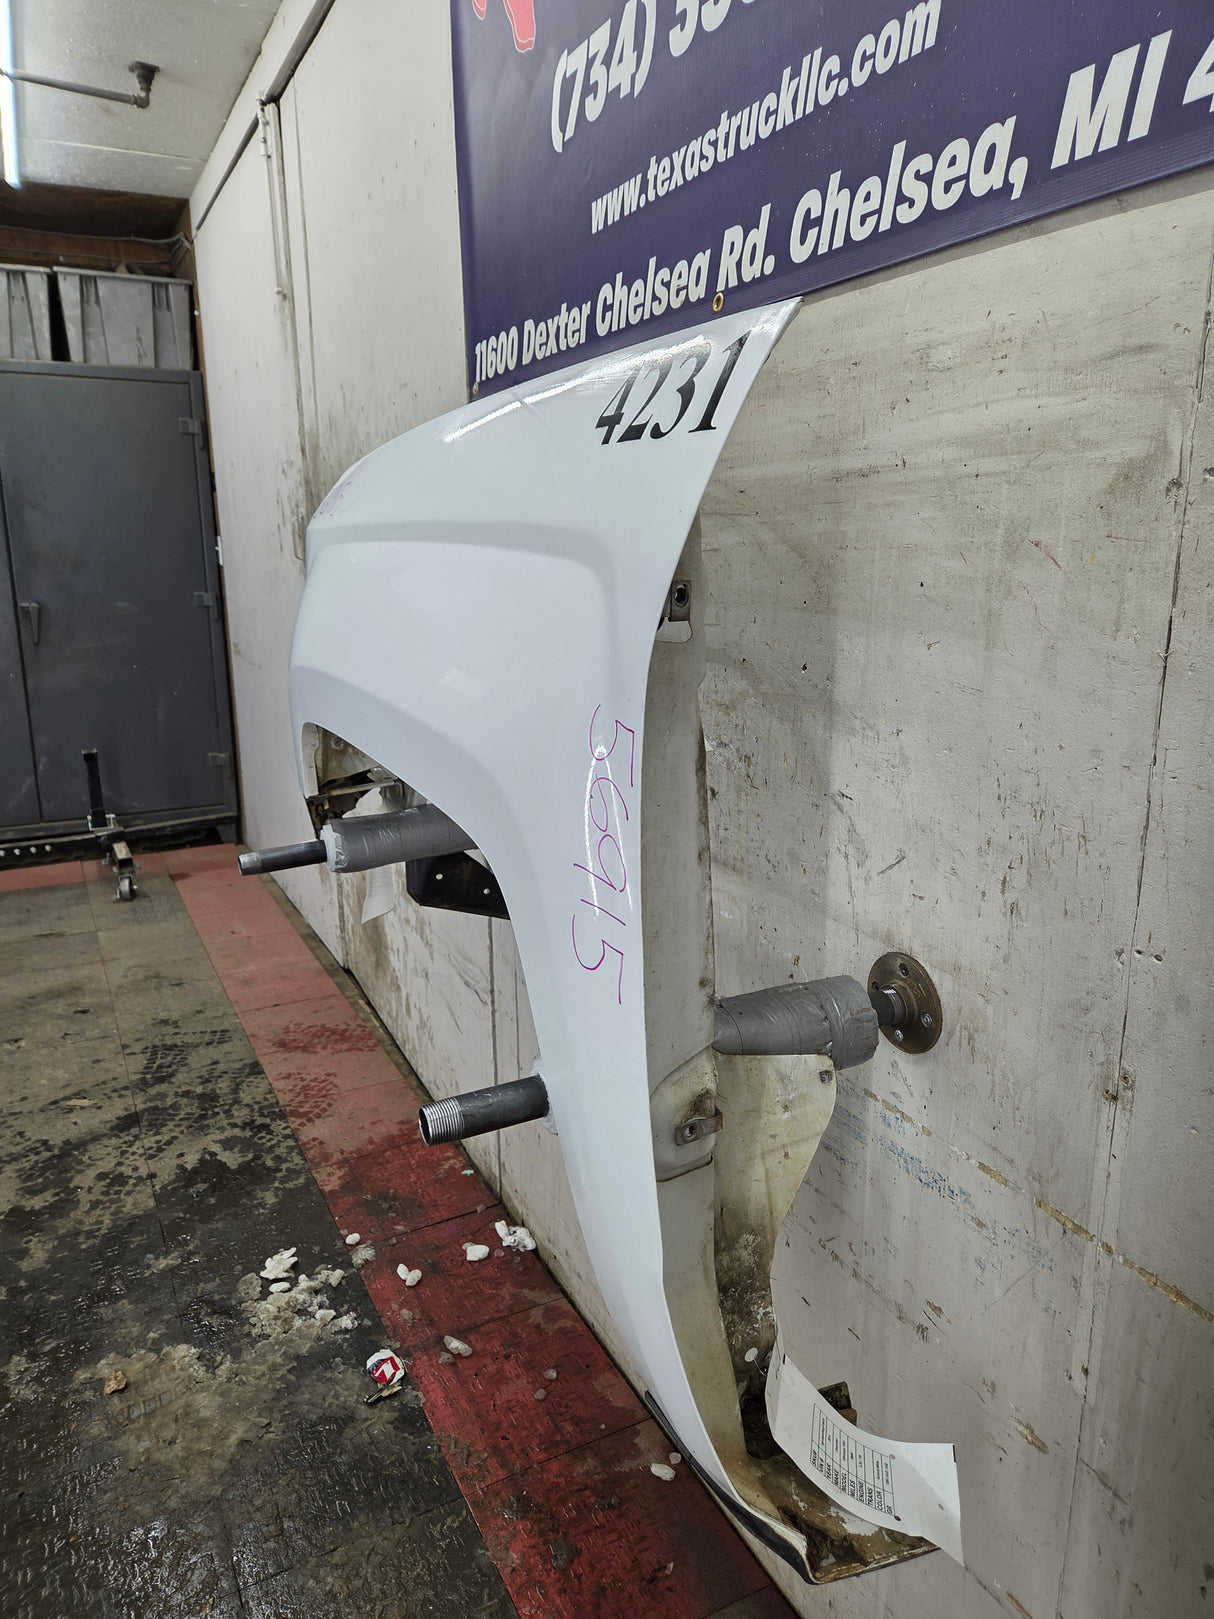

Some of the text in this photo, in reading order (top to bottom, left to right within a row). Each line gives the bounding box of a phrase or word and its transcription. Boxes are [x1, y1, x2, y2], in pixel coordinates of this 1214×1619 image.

[551, 0, 657, 153] (734)
[591, 0, 942, 234] www.texastruckllc.com
[475, 326, 519, 383] 11600
[522, 300, 591, 366] Dexter
[595, 249, 711, 337] Chelsea
[717, 203, 776, 292] Rd.
[789, 115, 1029, 264] Chelsea,
[1050, 29, 1173, 170] MI
[595, 330, 751, 445] 4231
